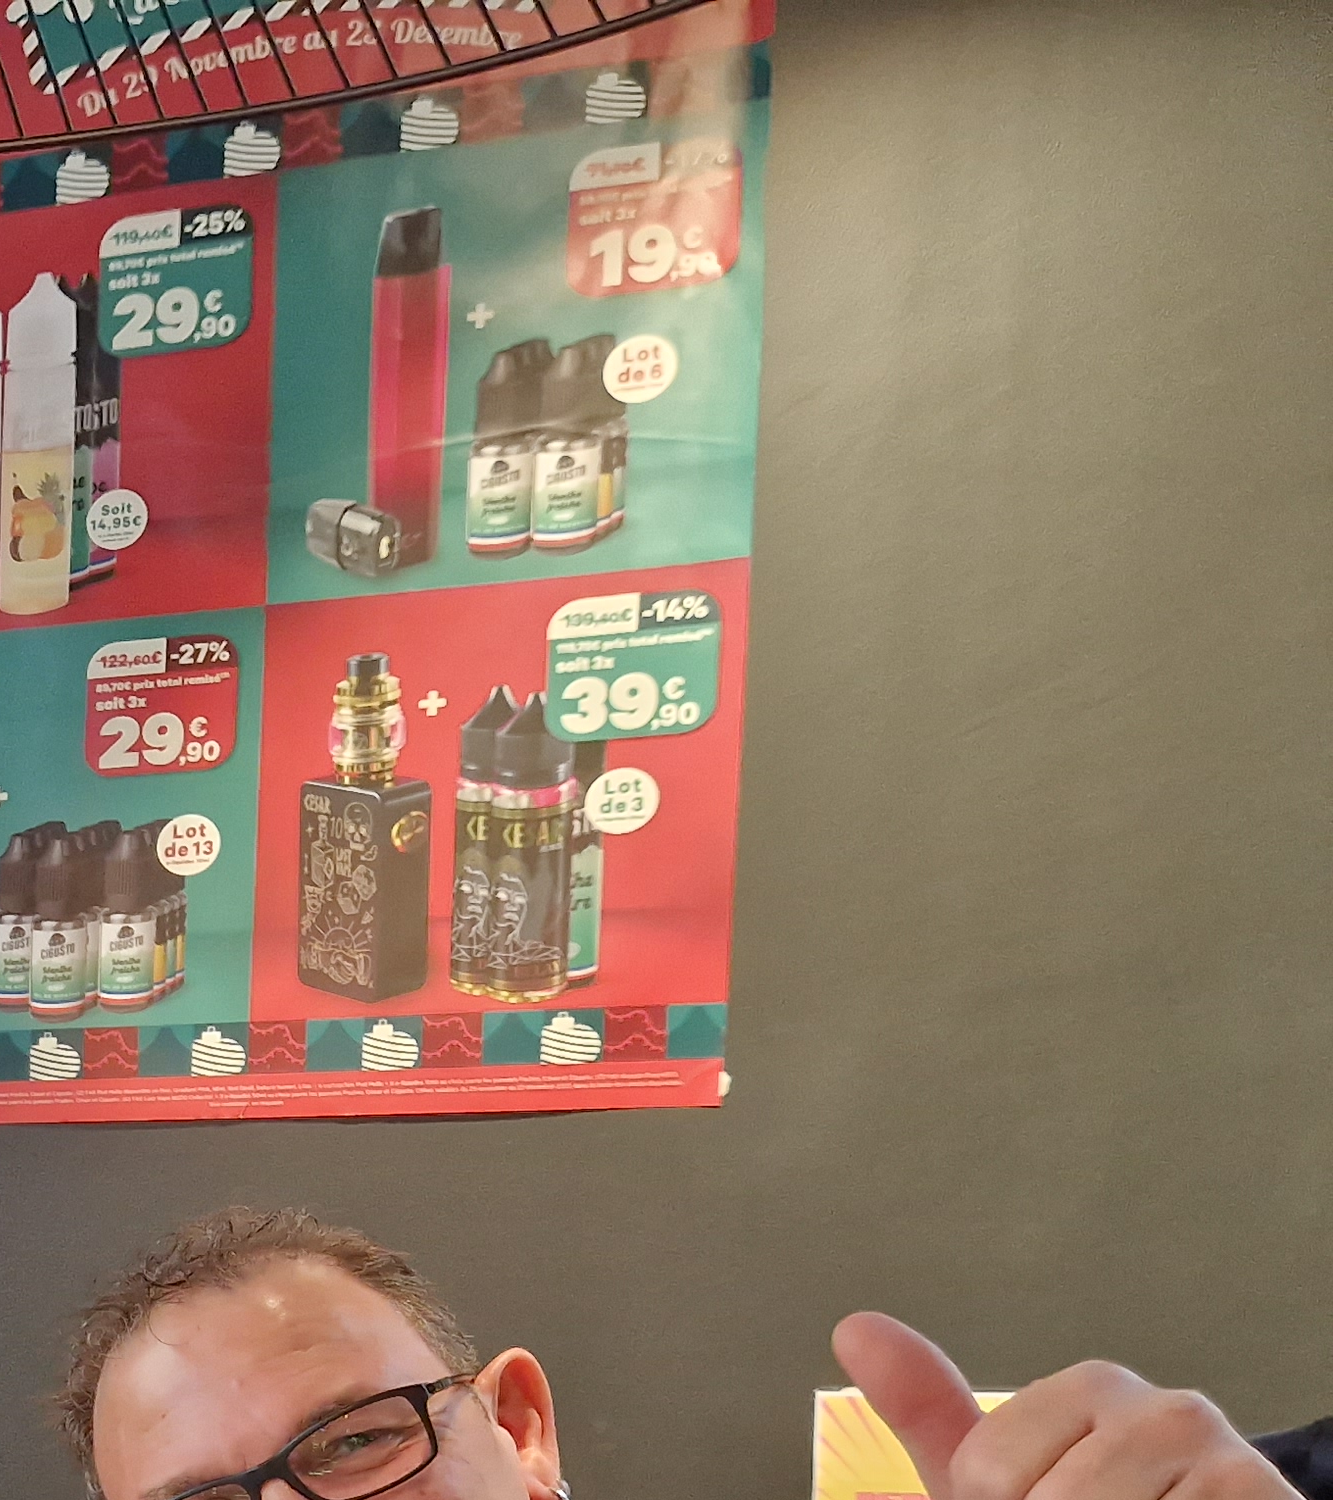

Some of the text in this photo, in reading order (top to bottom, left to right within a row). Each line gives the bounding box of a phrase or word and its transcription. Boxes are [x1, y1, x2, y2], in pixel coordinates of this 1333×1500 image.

[77, 86, 120, 119] Du
[121, 62, 159, 100] 29
[164, 32, 297, 85] Novembre
[184, 208, 247, 238] -25%
[589, 224, 678, 287] 19
[111, 286, 200, 351] 29
[622, 344, 662, 363] Lot
[617, 364, 664, 384] de 6
[100, 503, 132, 516] Soit
[90, 515, 142, 531] 14,95€
[641, 594, 710, 622] -14%
[97, 640, 230, 669] 122,60€ -27%
[95, 695, 147, 711] soit 3x
[560, 671, 660, 734] 39
[98, 711, 185, 769] 29
[603, 778, 643, 795] Lot
[599, 796, 646, 815] de 3
[172, 823, 208, 840] Lot
[164, 840, 215, 858] de 13
[40, 942, 76, 960] CIGUSTO
[109, 935, 144, 952] CIGUSTO
[42, 965, 74, 976] Menthe
[111, 957, 142, 967] Menthe
